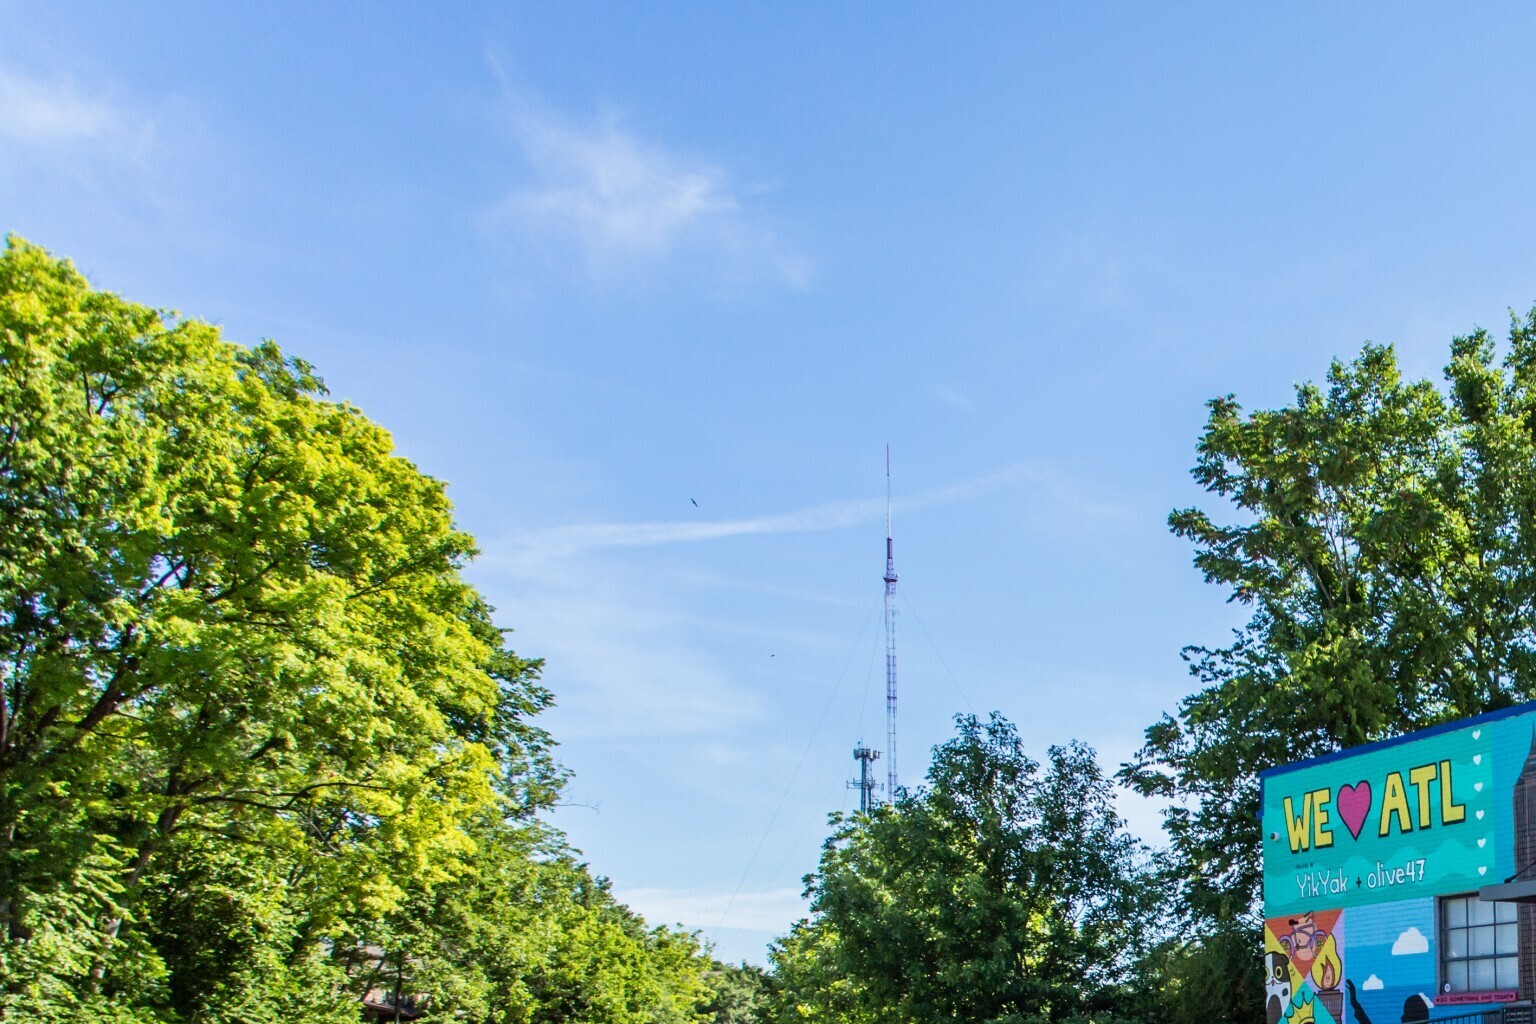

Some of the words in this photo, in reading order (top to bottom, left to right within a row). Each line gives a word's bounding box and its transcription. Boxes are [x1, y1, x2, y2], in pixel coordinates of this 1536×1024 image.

[1283, 787, 1334, 854] WE
[1378, 759, 1466, 839] ATL
[1296, 868, 1348, 899] YikYak
[1367, 858, 1426, 889] olive47
